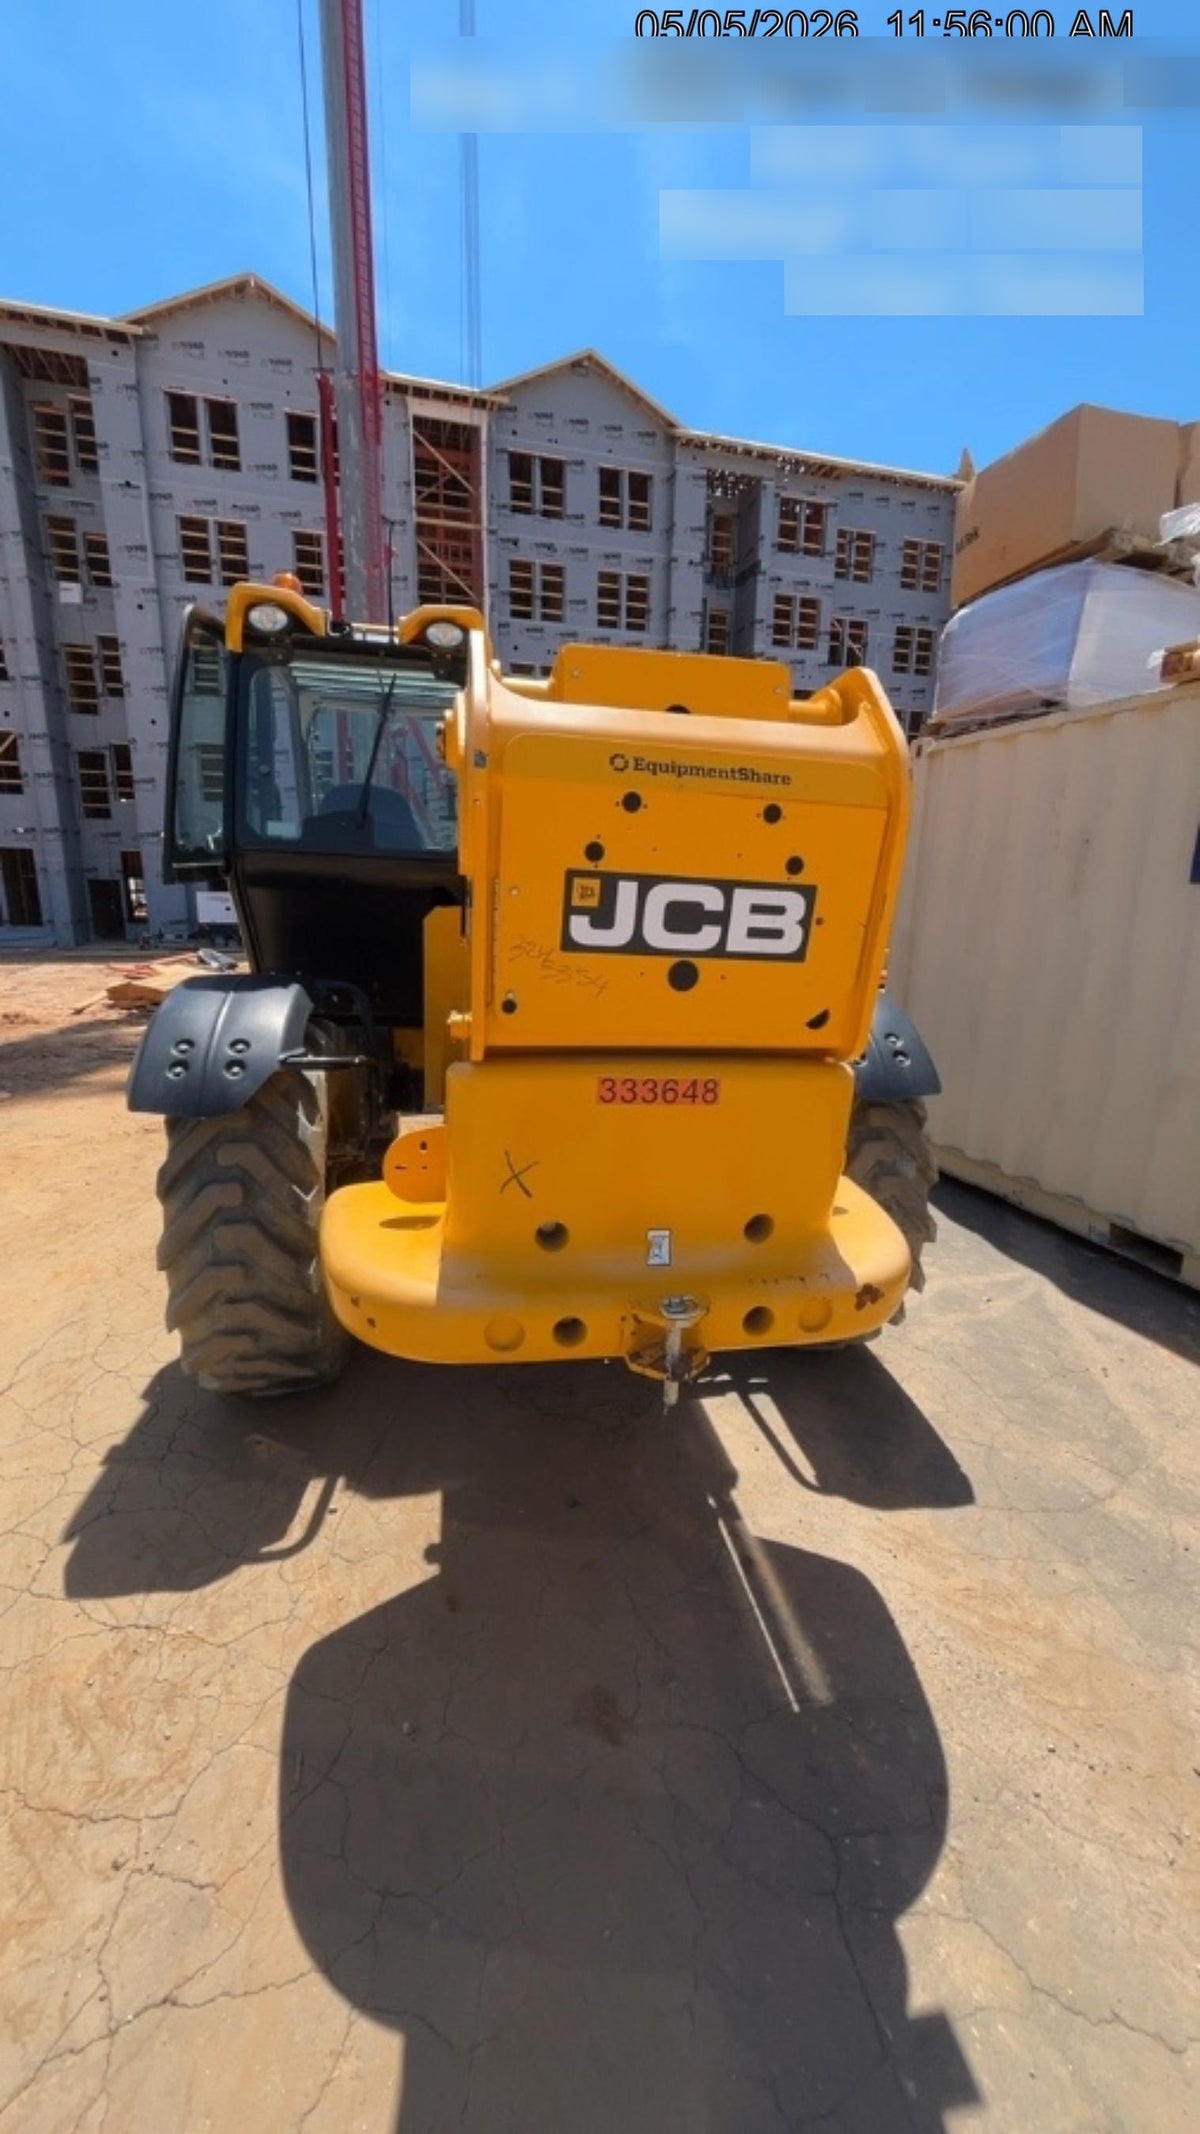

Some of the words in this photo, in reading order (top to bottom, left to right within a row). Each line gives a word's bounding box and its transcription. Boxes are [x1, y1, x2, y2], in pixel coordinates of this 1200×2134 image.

[633, 756, 792, 786] EquipmentShare
[569, 879, 807, 955] JCB
[599, 1078, 719, 1104] 333648
